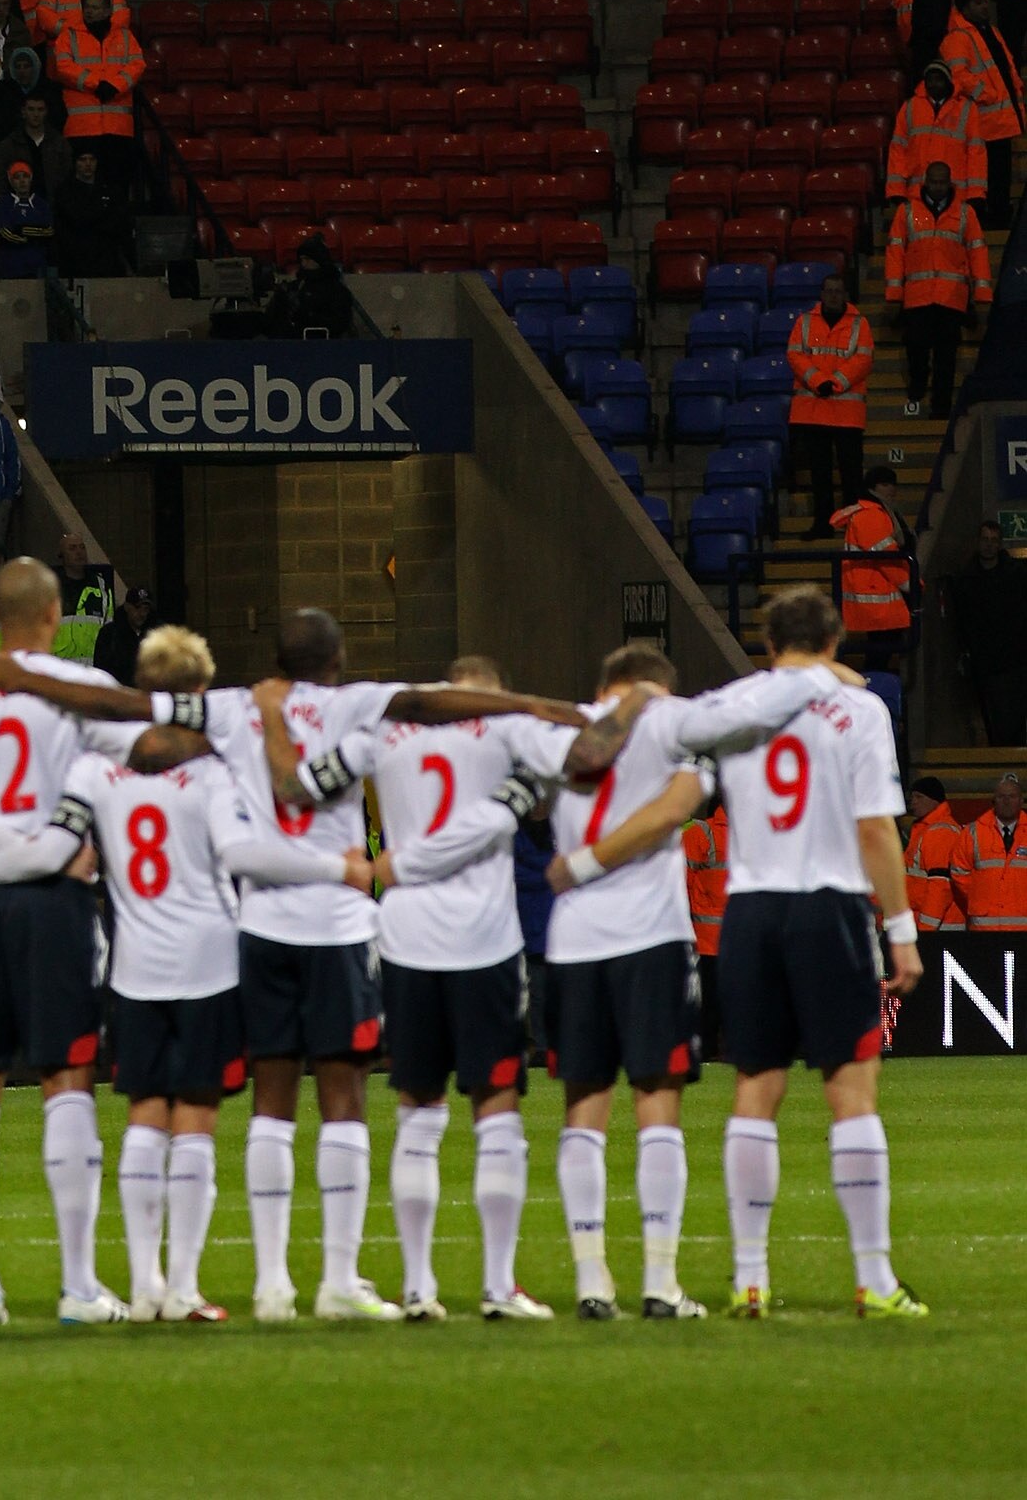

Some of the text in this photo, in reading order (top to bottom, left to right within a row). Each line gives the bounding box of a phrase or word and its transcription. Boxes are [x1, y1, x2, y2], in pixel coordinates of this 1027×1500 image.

[91, 363, 412, 435] Reebok
[765, 734, 811, 833] 9
[126, 804, 171, 899] 8
